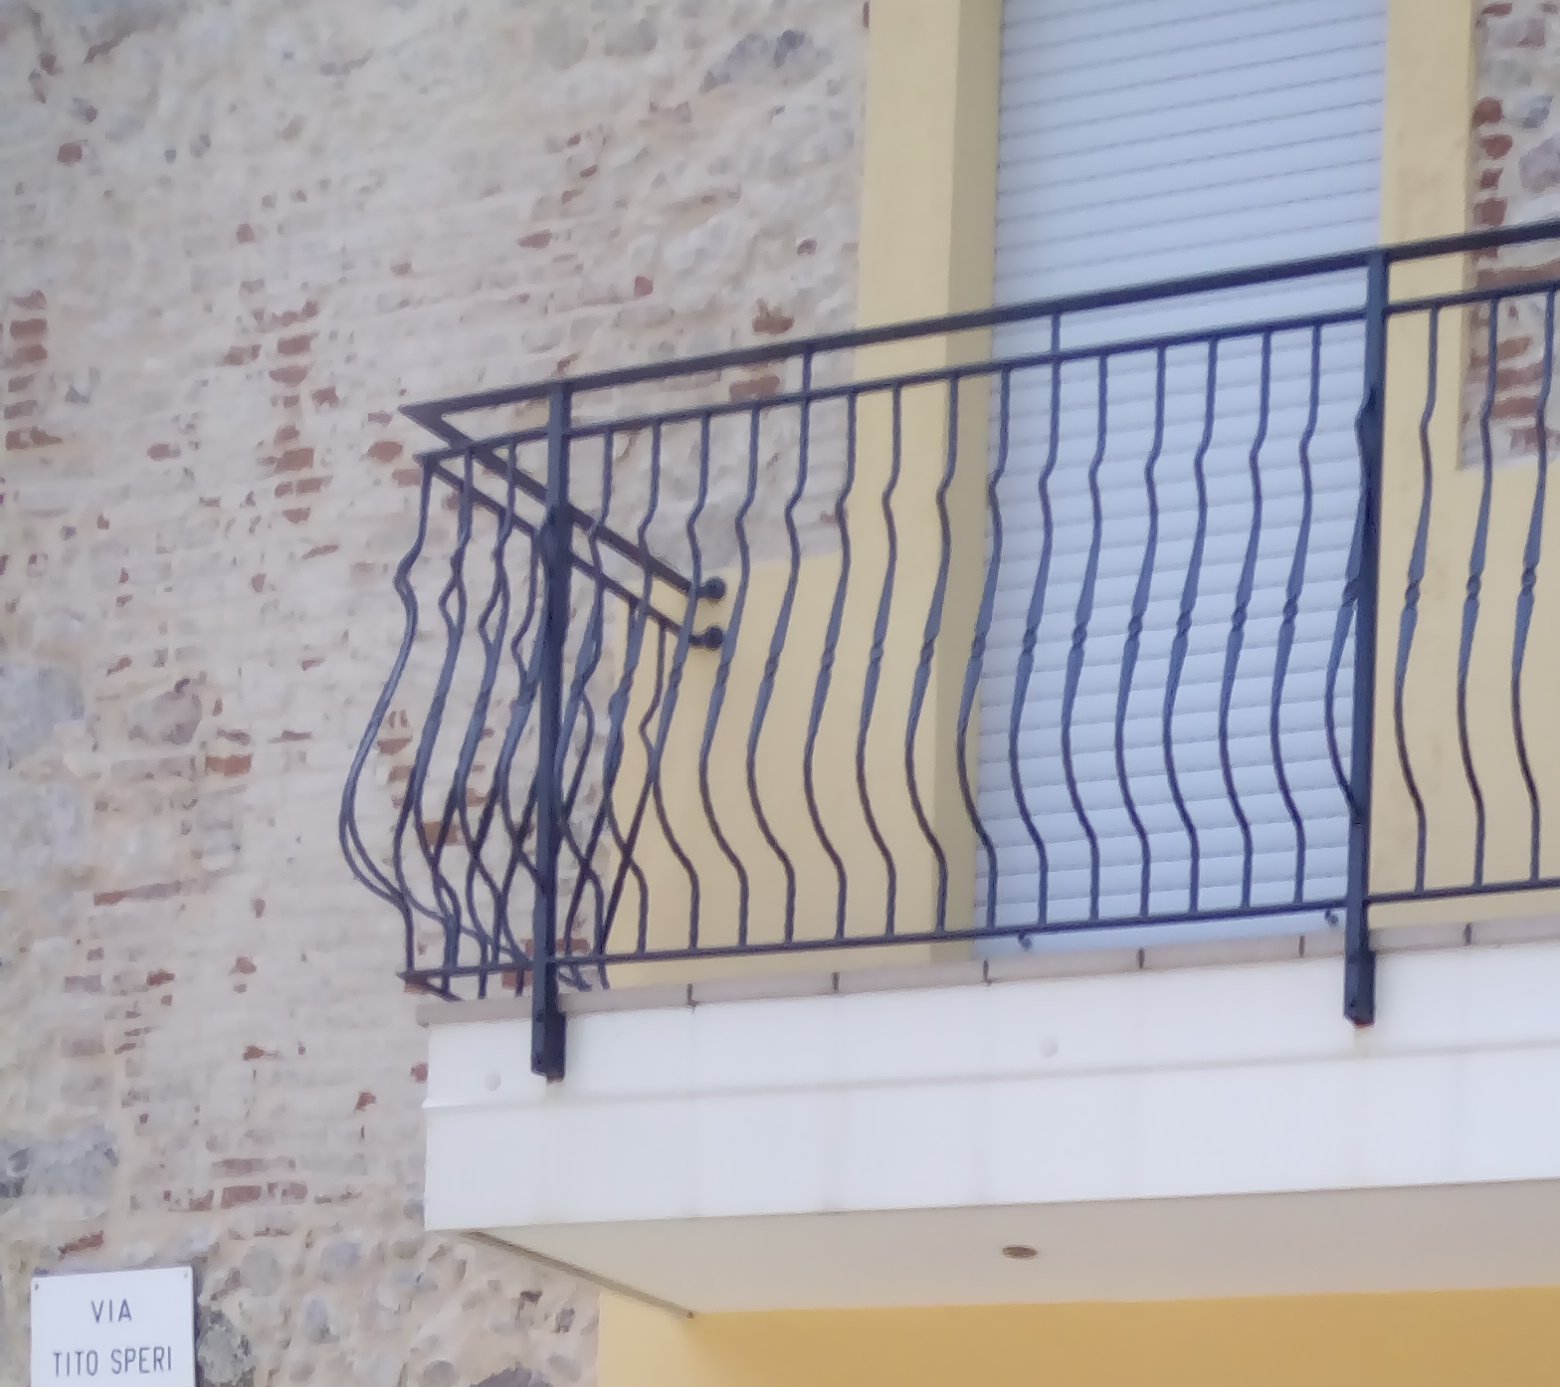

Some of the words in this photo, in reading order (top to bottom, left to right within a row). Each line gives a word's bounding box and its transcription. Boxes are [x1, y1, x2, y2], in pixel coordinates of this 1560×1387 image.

[91, 1298, 133, 1323] VIA
[53, 1350, 99, 1377] TITO
[110, 1346, 173, 1375] SPERI
